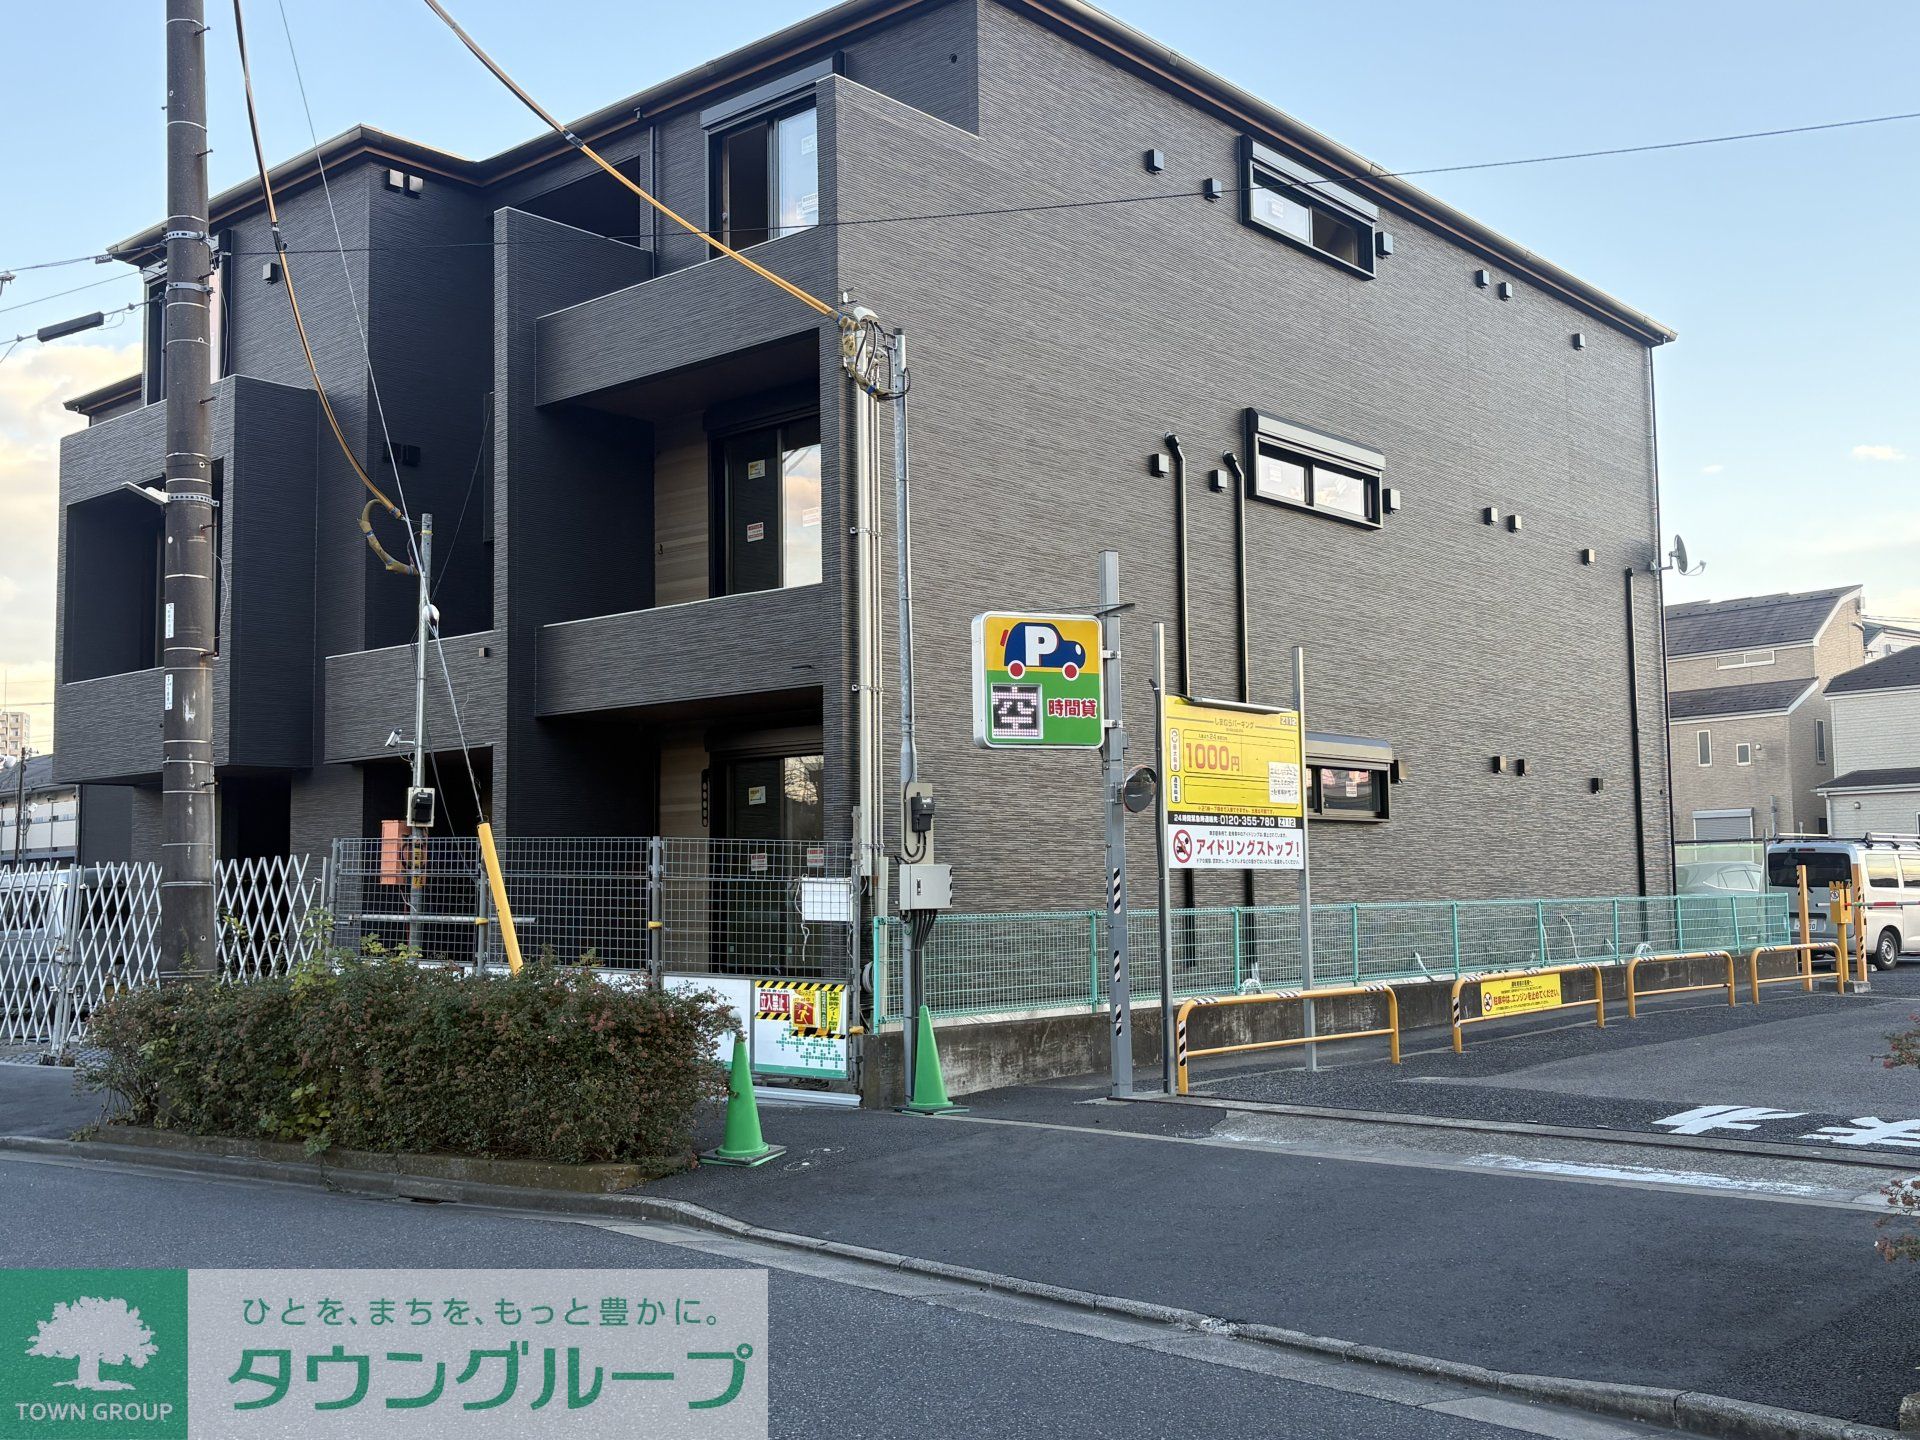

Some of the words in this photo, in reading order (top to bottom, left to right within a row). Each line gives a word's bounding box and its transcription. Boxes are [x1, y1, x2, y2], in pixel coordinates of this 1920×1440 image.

[1025, 626, 1057, 666] P
[993, 686, 1039, 737] 空
[1047, 698, 1098, 719] 時間貸
[1186, 742, 1240, 771] 1000円
